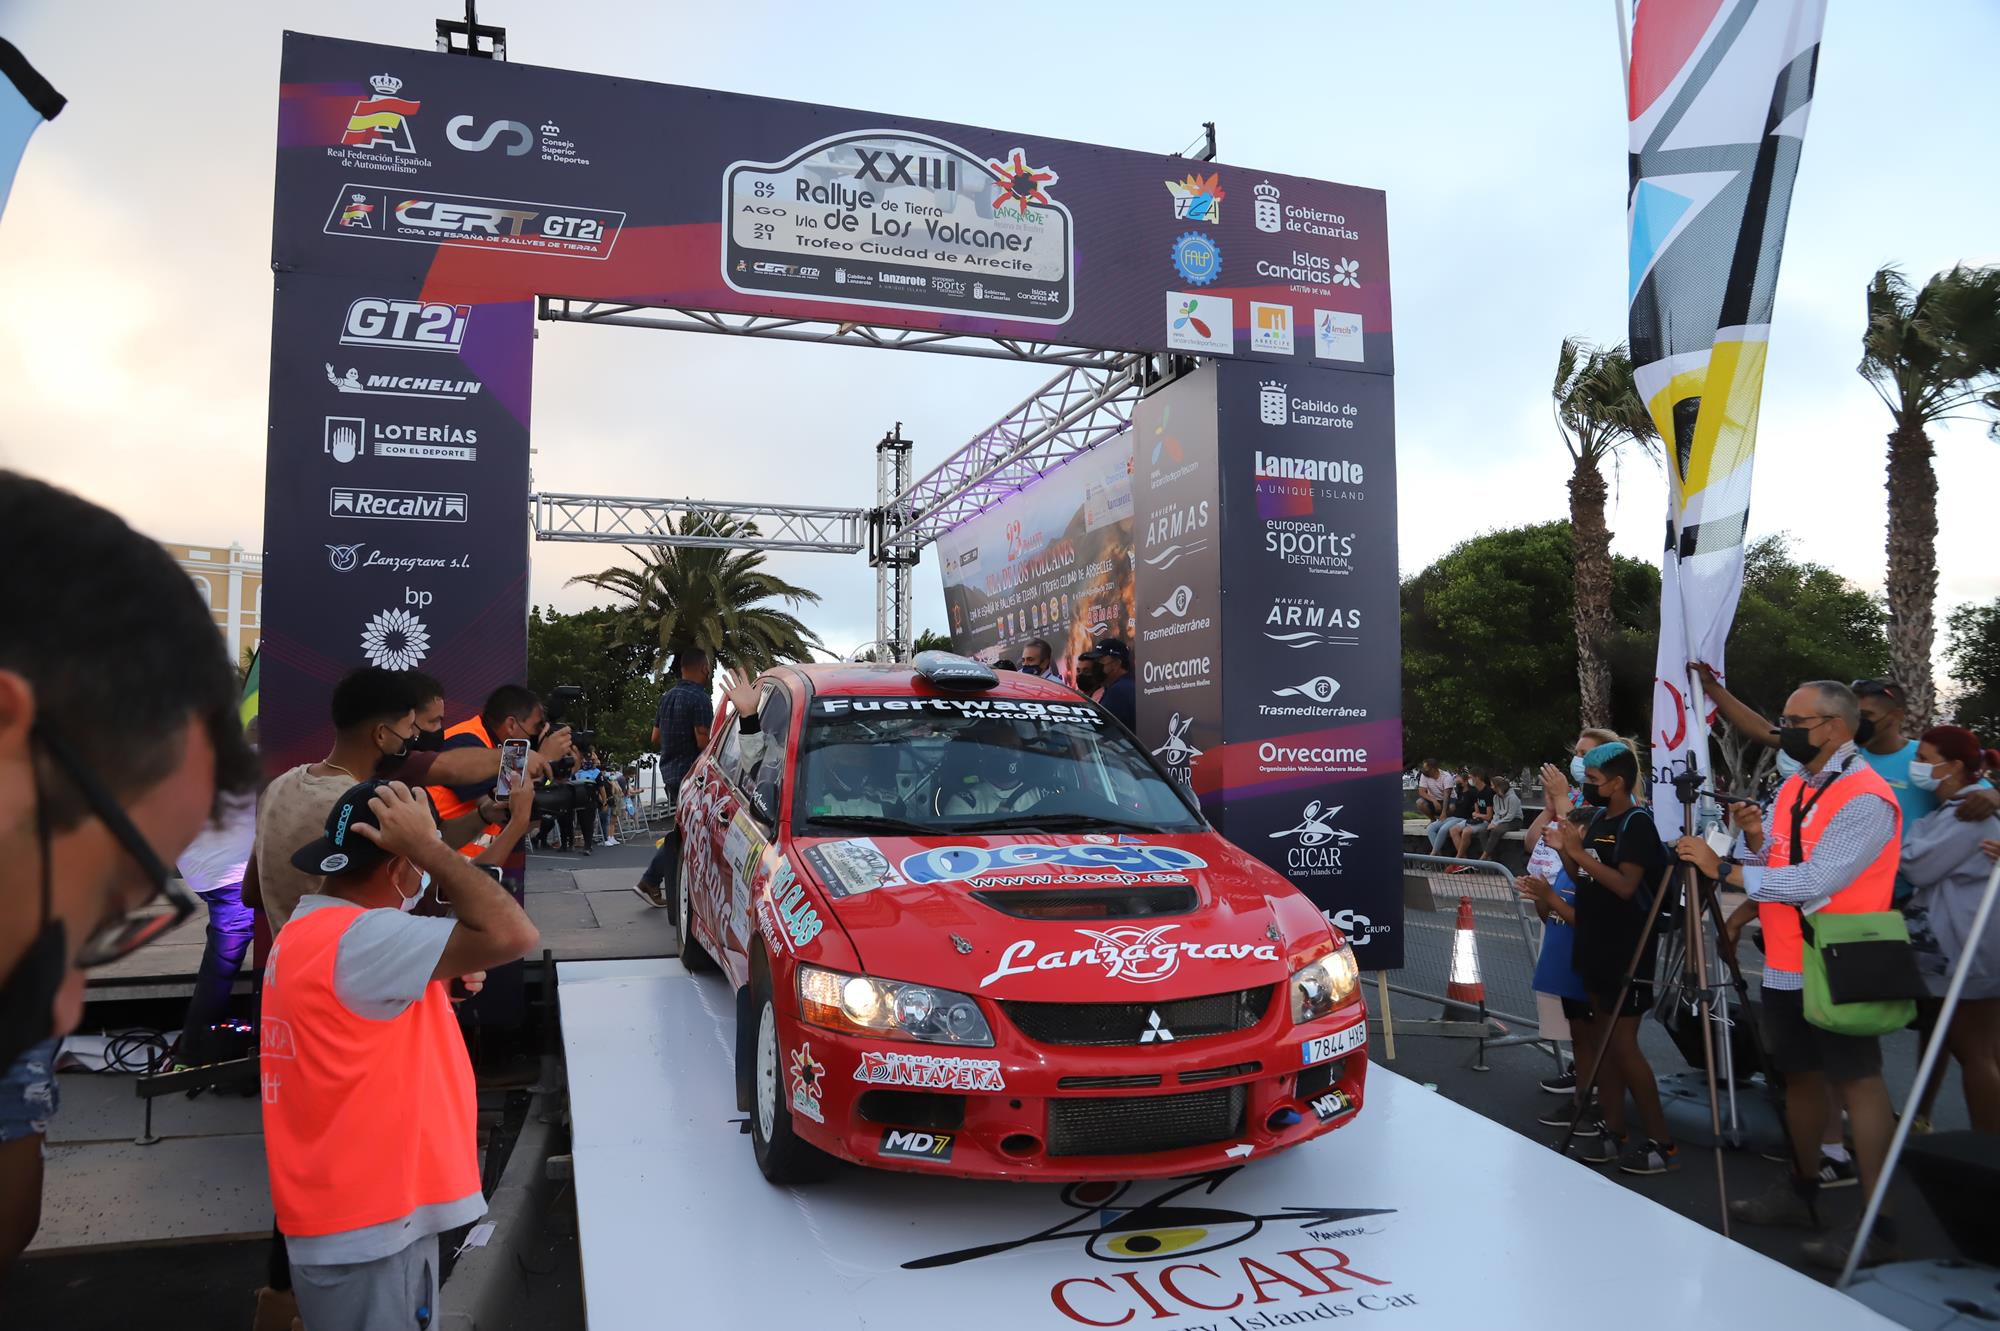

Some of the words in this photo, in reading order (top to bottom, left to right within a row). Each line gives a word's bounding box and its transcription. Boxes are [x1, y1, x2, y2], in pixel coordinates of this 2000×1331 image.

[542, 138, 575, 149] Consejo
[542, 146, 576, 156] Superior
[327, 147, 345, 157] Real
[347, 150, 393, 163] Federación
[395, 155, 432, 168] Española
[341, 158, 352, 167] de
[353, 160, 418, 174] Automovilismo
[553, 155, 590, 166] Deportes
[853, 148, 956, 191] XXIII
[754, 181, 775, 190] 06
[754, 189, 775, 199] 07
[796, 178, 876, 212] Rallye
[881, 200, 899, 212] de
[904, 202, 943, 217] Tierra
[742, 205, 787, 217] AGO
[1285, 205, 1346, 225] Gobierno
[543, 214, 606, 242] GT2i
[754, 223, 775, 232] 20
[754, 232, 773, 241] 21
[796, 214, 818, 229] Isla
[824, 208, 860, 232] de
[871, 212, 912, 238] Los
[925, 219, 1033, 252] Volcanes
[1286, 218, 1302, 232] de
[1303, 222, 1360, 241] Canarias
[397, 227, 426, 236] COPA
[444, 231, 484, 242] ESPAÑA
[486, 235, 500, 243] DE
[502, 237, 546, 248] RALLYES
[548, 241, 562, 249] DE
[563, 243, 598, 252] TIERRA
[796, 235, 854, 251] Trofeo
[860, 242, 928, 259] Ciudad
[934, 251, 958, 263] de
[964, 254, 1033, 271] Arrecife
[1292, 250, 1330, 270] Islas
[878, 271, 927, 287] Lanzarote
[1256, 260, 1331, 285] Canarias
[347, 299, 469, 344] GT2i
[367, 374, 482, 394] MICHELIN
[1291, 398, 1339, 414] Cabildo
[1342, 402, 1358, 416] de
[1292, 412, 1354, 429] Lanzarote
[374, 423, 478, 444] LOTERÍAS
[385, 446, 406, 454] CON
[422, 448, 466, 457] DEPORTE
[1255, 450, 1365, 485] Lanzarote
[1255, 484, 1263, 493] A
[1269, 485, 1316, 497] UNIQUE
[1321, 489, 1365, 501] ISLAND
[355, 493, 444, 517] Recalvi
[1145, 500, 1209, 548] ARMAS
[1266, 519, 1325, 534] european
[1265, 531, 1353, 559] sports
[362, 550, 446, 572] Lanzagrava
[449, 554, 470, 568] s.l.
[1287, 554, 1348, 568] DESTINATION
[405, 586, 433, 609] bp
[1274, 597, 1316, 606] NAVIERA
[1265, 605, 1361, 629] ARMAS
[1143, 656, 1211, 684] Orvecame
[823, 698, 1099, 718] Fuertwagen
[962, 709, 1105, 726] Motorsport
[1258, 742, 1368, 763] Orvecame
[1287, 847, 1342, 868] CICAR
[966, 872, 1190, 888] www.occp.es
[1288, 869, 1310, 878] Canary
[1310, 868, 1331, 876] Islands
[1331, 868, 1343, 876] Car
[1364, 925, 1391, 934] GRUPO
[979, 938, 1280, 988] Lanzagrava
[1314, 1034, 1345, 1060] 7844
[1347, 1024, 1365, 1049] HXB
[888, 1054, 999, 1067] Rotulaciones
[885, 1131, 951, 1155] MD7
[1050, 1247, 1393, 1327] CICAR
[1228, 1301, 1355, 1331] Islands
[1357, 1291, 1420, 1312] Car
